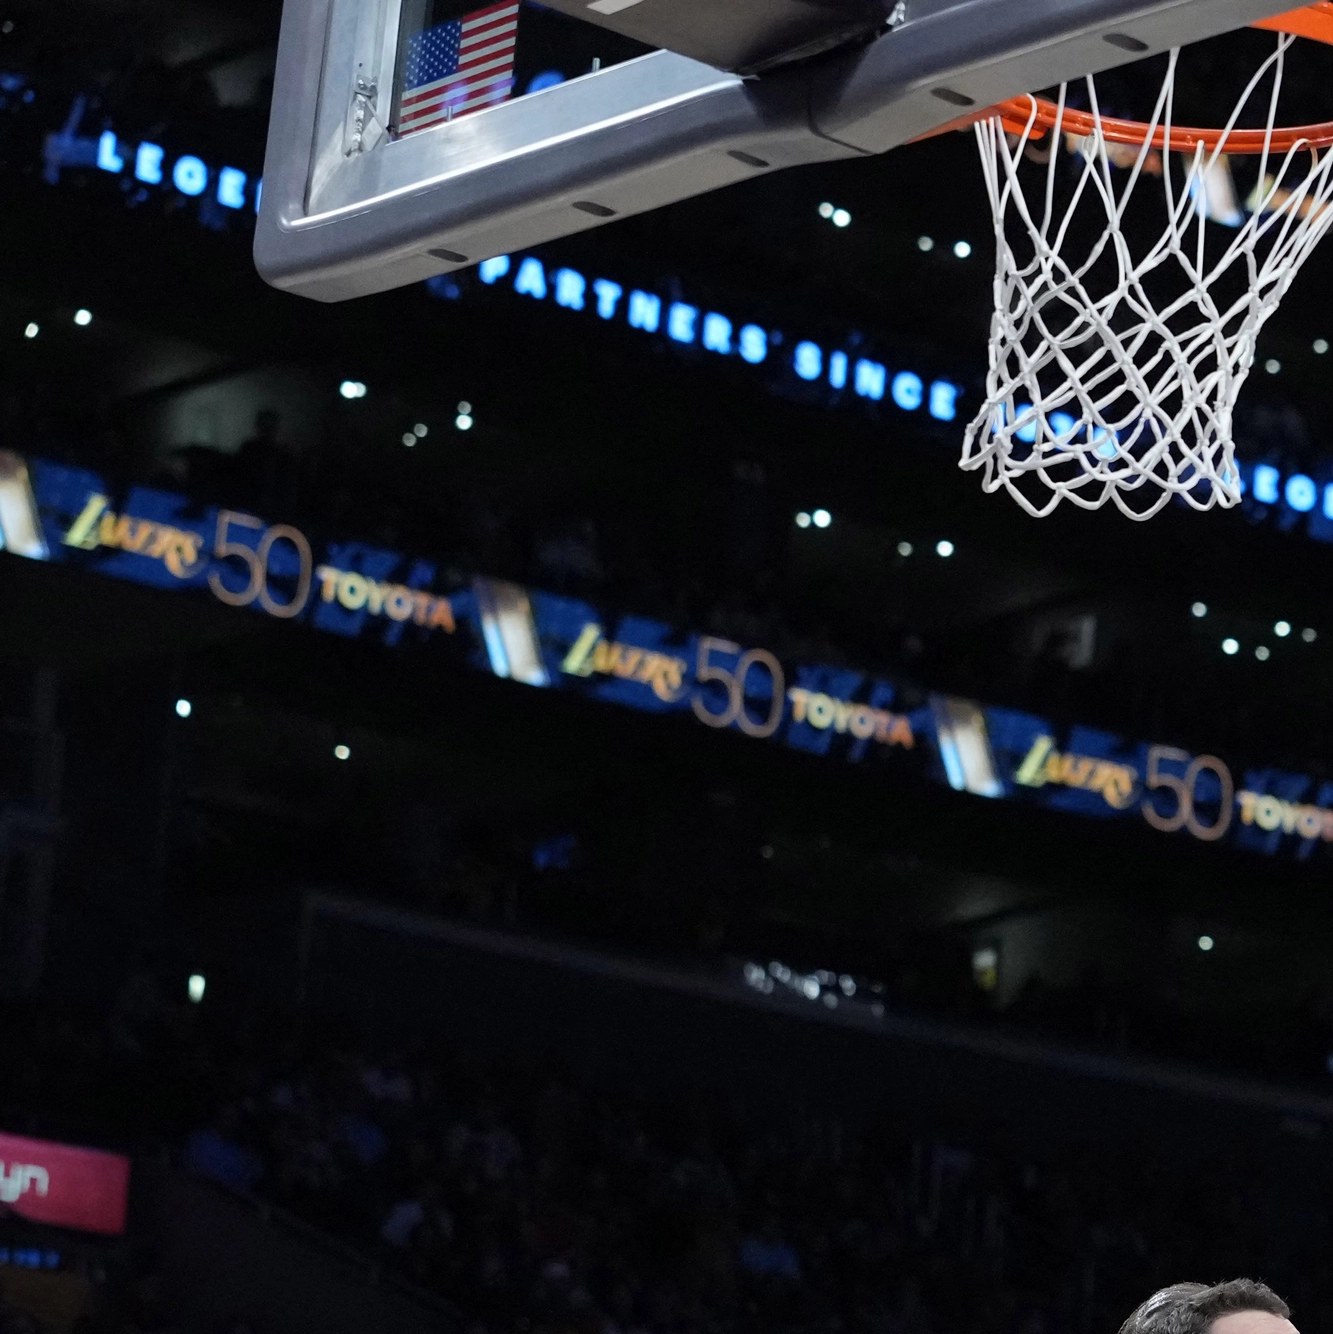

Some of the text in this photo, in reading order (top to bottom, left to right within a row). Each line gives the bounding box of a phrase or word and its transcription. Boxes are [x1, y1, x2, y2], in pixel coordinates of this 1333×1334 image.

[479, 255, 768, 364] PARTNERS
[795, 341, 957, 422] SINCE
[208, 509, 312, 618] 50
[317, 565, 456, 633] TOYOTA
[691, 635, 785, 738] 50
[788, 687, 914, 749] TOYOTA
[1140, 744, 1234, 841] 50
